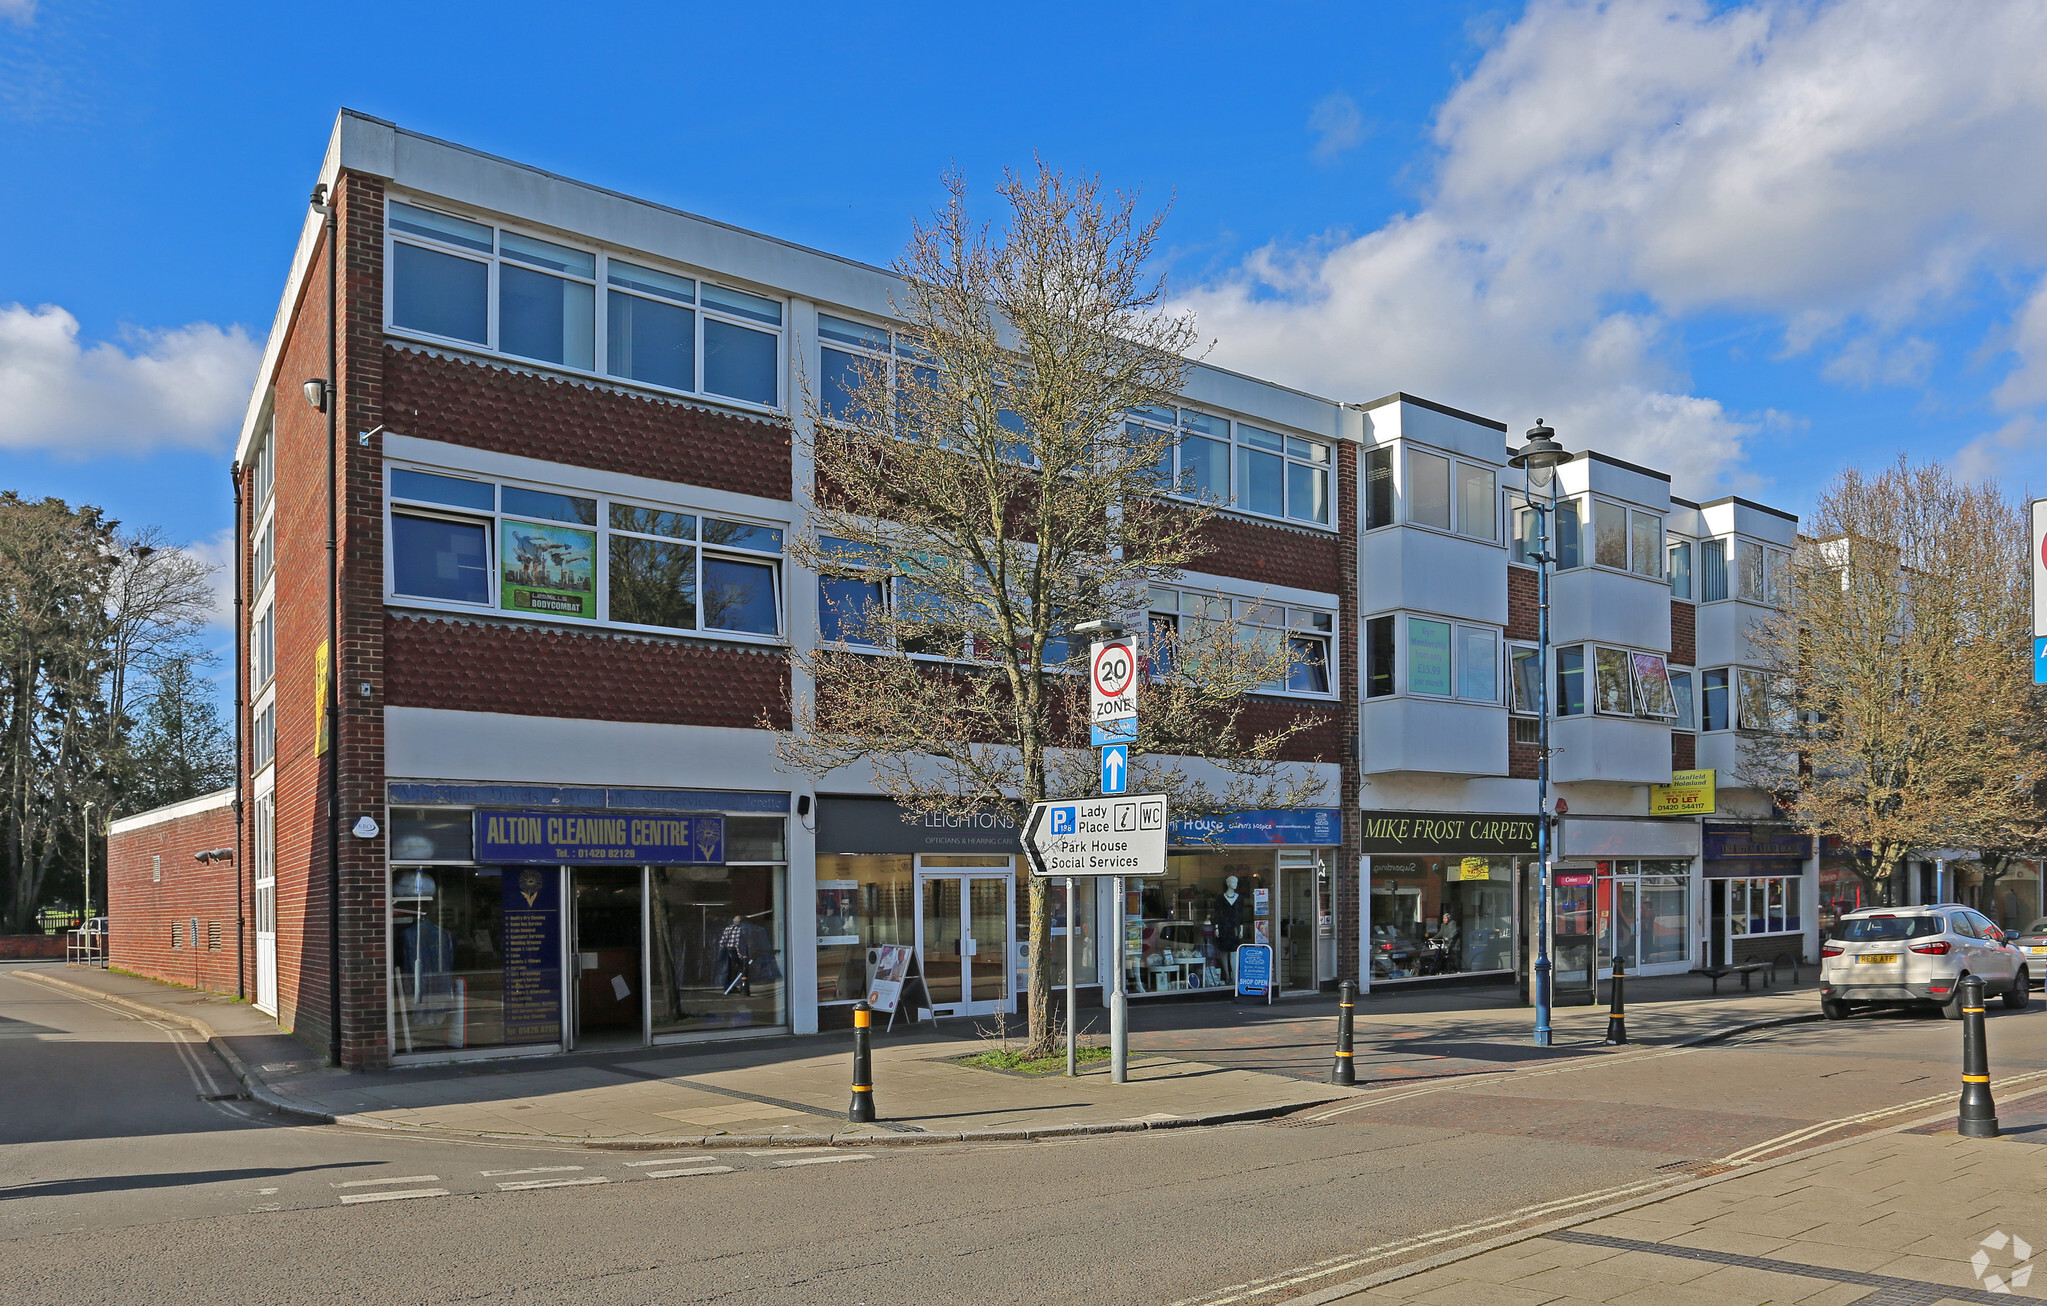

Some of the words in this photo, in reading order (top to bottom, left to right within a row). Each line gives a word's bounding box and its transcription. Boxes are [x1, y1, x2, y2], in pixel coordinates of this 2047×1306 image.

[531, 599, 581, 612] BODYCOMBAT
[1422, 626, 1436, 637] Gym
[1411, 637, 1447, 650] Membership
[1101, 659, 1127, 682] 20
[1417, 663, 1441, 675] £15.99
[1414, 678, 1425, 687] per
[1425, 678, 1444, 688] month
[1097, 699, 1131, 716] ZONE
[1673, 779, 1707, 787] Holmlund
[1674, 773, 1706, 781] Glanfield
[1681, 796, 1699, 804] LET
[1681, 802, 1705, 810] 544117
[924, 811, 1015, 829] LEIGHTONS
[1053, 810, 1067, 833] P
[1080, 804, 1108, 819] Lady
[1142, 807, 1161, 824] WC
[487, 816, 542, 845] ALTON
[547, 818, 627, 846] CLEANING
[631, 819, 689, 847] CENTRE
[1078, 820, 1110, 833] Place
[1252, 822, 1273, 832] hospice
[1364, 818, 1410, 844] MIKE
[1412, 819, 1465, 844] FROST
[1469, 820, 1535, 845] CARPETS
[924, 837, 961, 845] OPTICIANS
[967, 838, 997, 846] HEARING
[997, 838, 1013, 846] CARE
[1061, 840, 1087, 853] Park
[1091, 839, 1128, 852] House
[555, 848, 570, 858] Tel.
[577, 848, 606, 859] 01420
[607, 849, 636, 859] 82128
[1051, 856, 1085, 869] Social
[1089, 855, 1139, 868] Services
